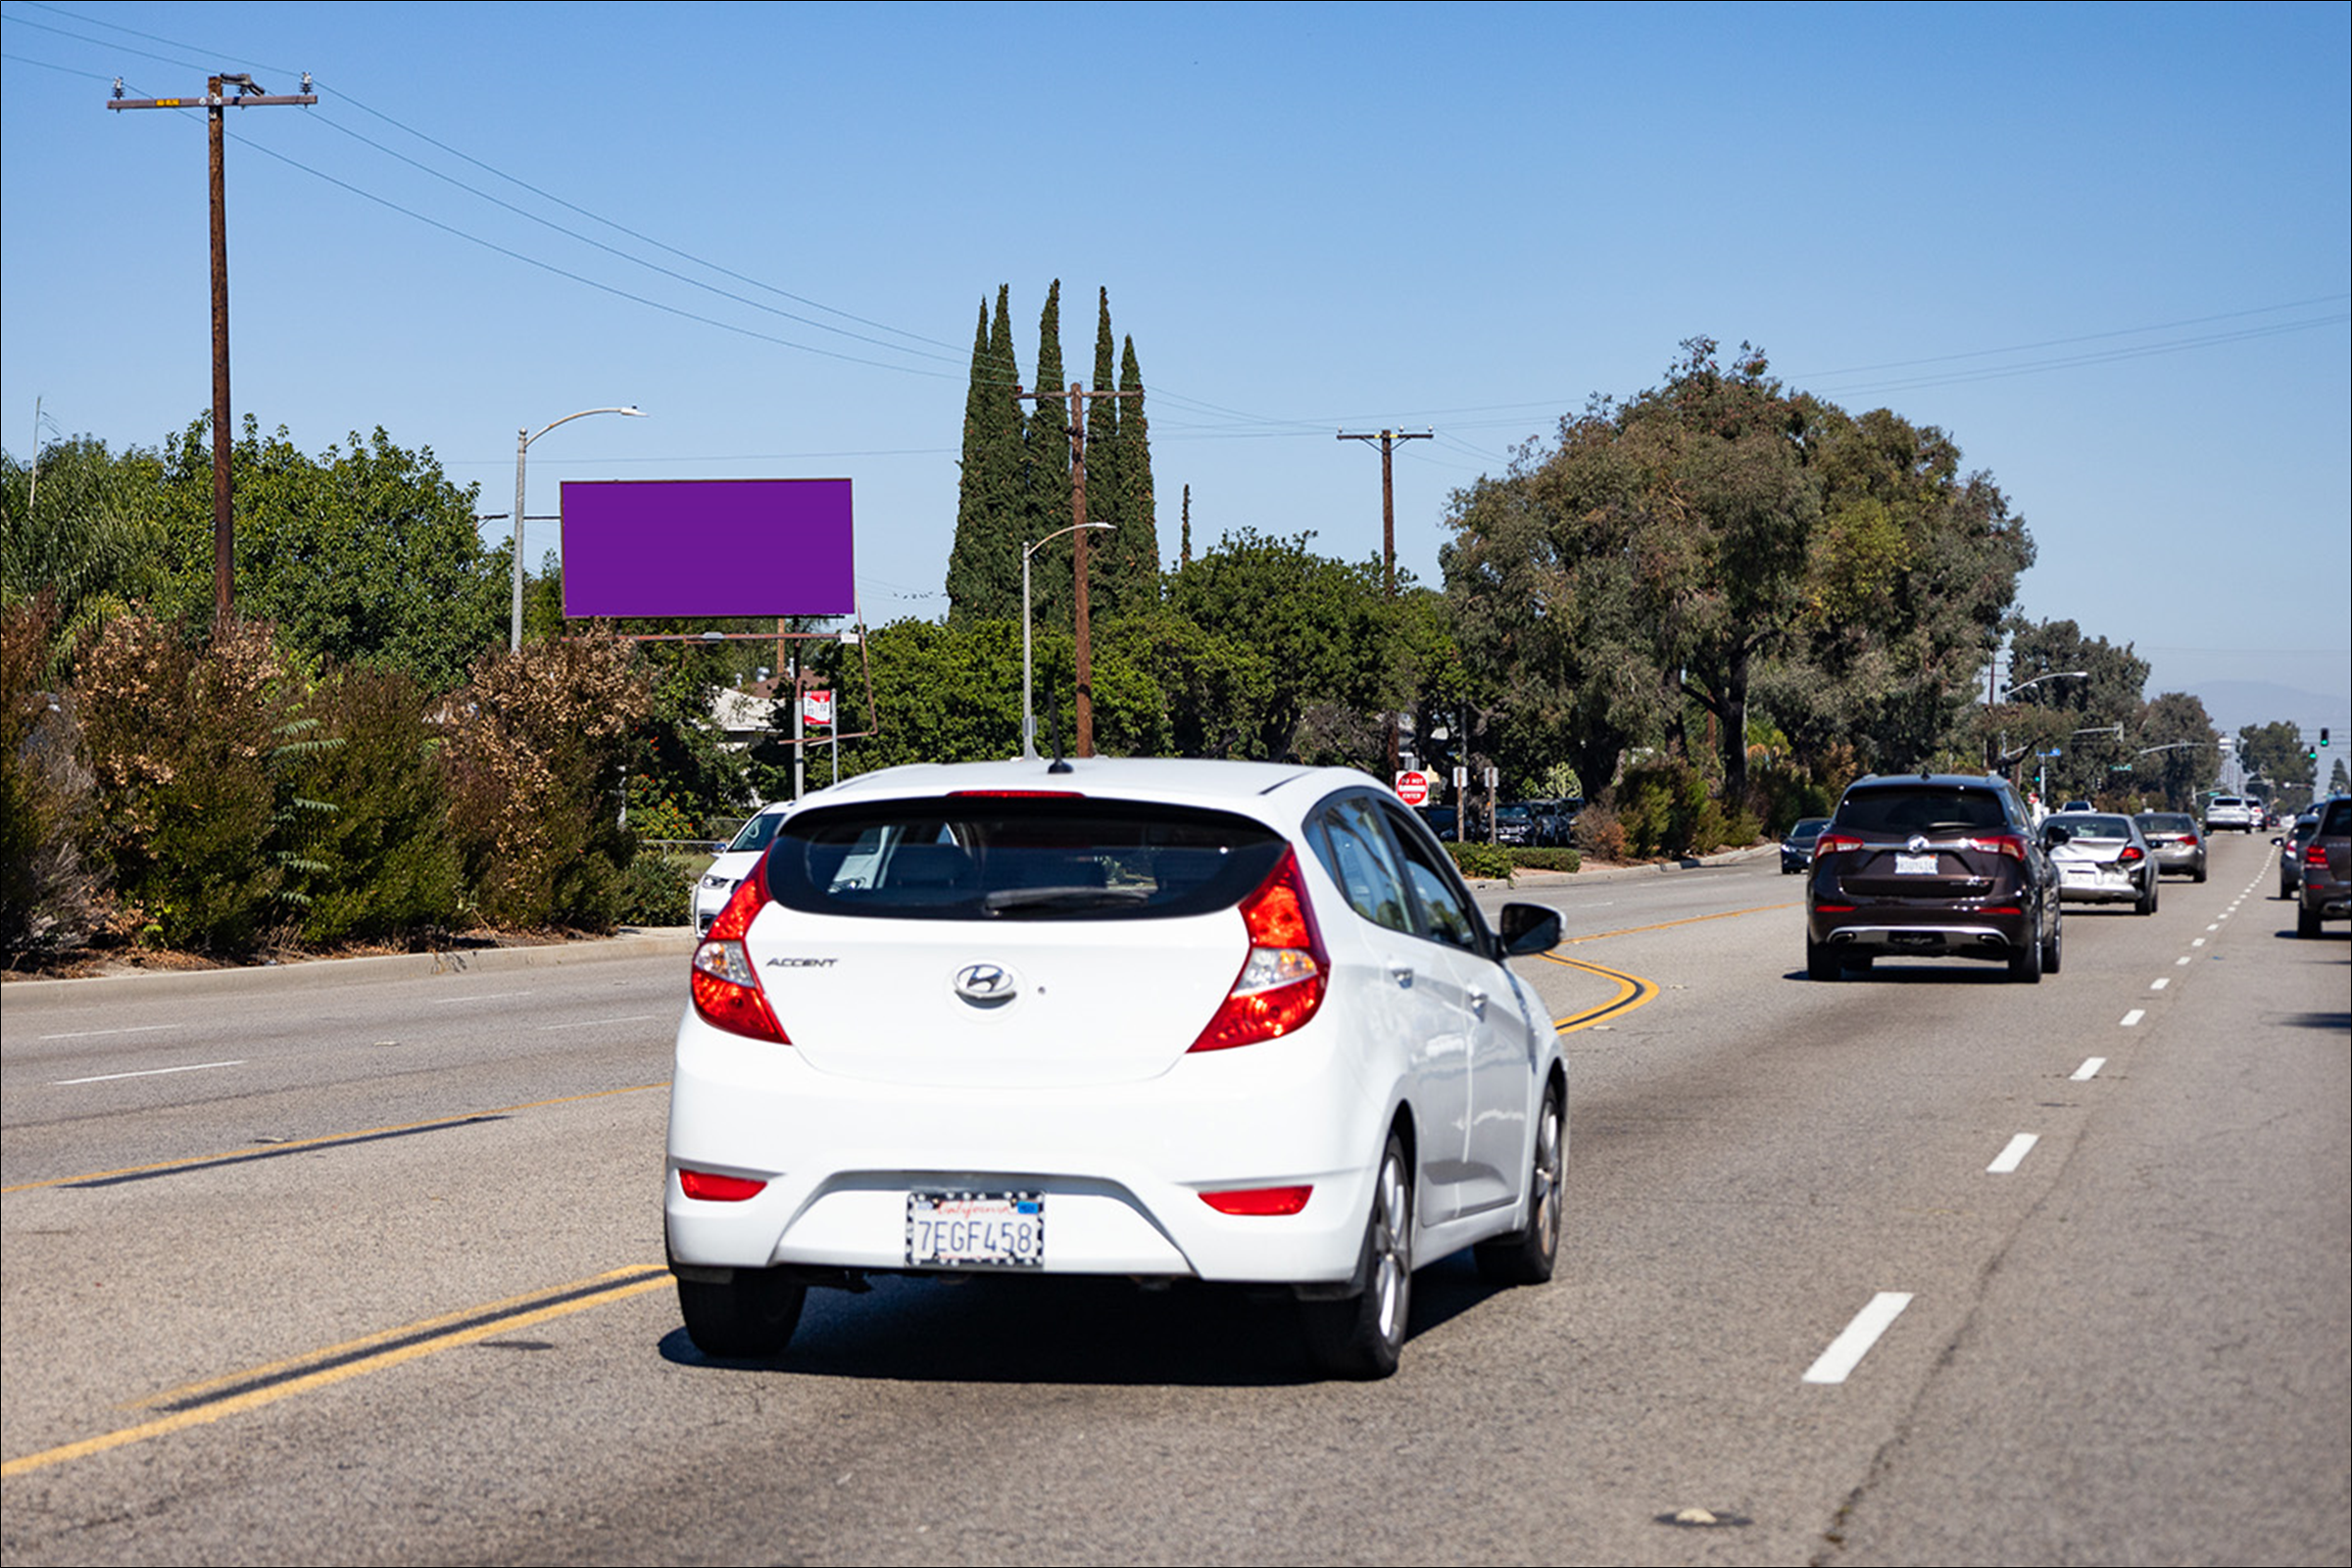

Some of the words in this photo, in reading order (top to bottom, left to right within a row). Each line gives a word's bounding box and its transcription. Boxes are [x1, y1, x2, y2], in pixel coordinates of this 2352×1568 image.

[765, 957, 839, 967] ACCENT
[937, 1200, 1010, 1219] California
[917, 1220, 1033, 1253] 7EGF458
